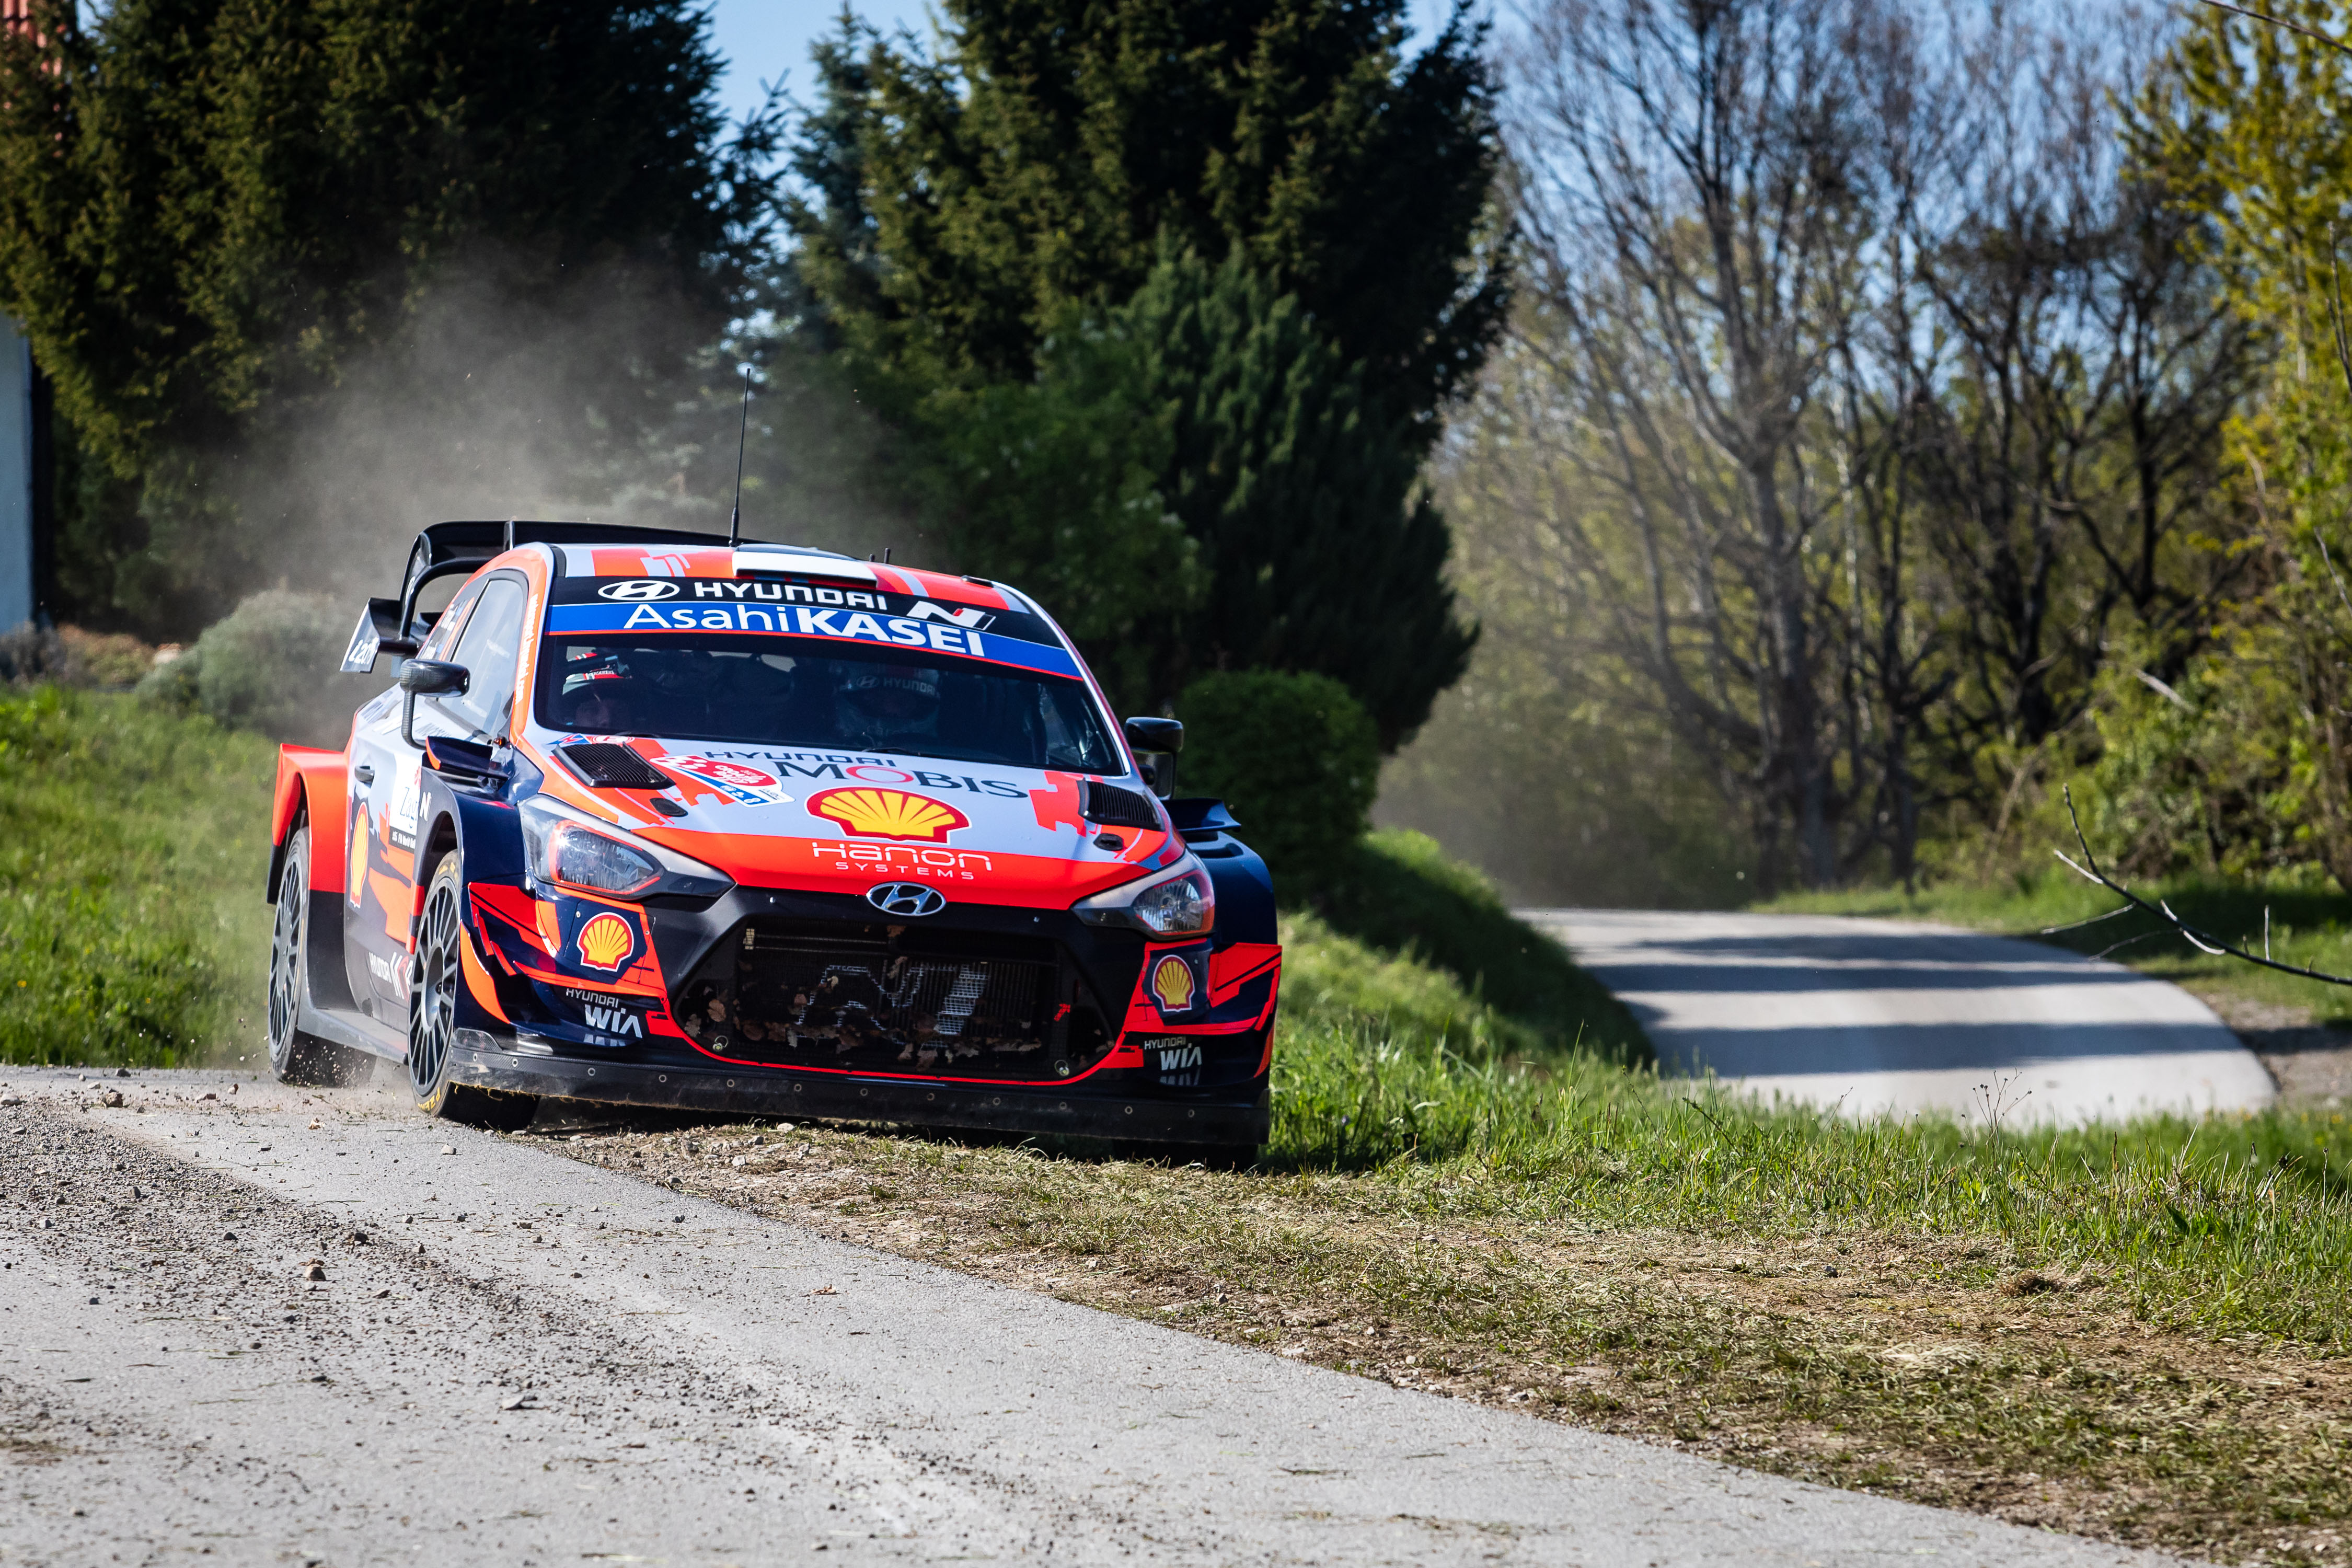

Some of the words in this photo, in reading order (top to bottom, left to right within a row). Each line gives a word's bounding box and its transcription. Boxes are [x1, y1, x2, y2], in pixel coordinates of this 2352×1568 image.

[694, 582, 887, 610] HYUNDAI
[705, 751, 897, 767] HYUNDAI
[770, 761, 1028, 799] MOBIS
[812, 841, 992, 871] Hanon
[835, 862, 974, 880] SYSTEMS
[368, 951, 392, 984] HYUNDAI
[566, 988, 619, 1008] HYUNDAI
[584, 1004, 643, 1039] WIA
[1144, 1036, 1186, 1050] HYUNDAI
[1160, 1043, 1202, 1071] WIA
